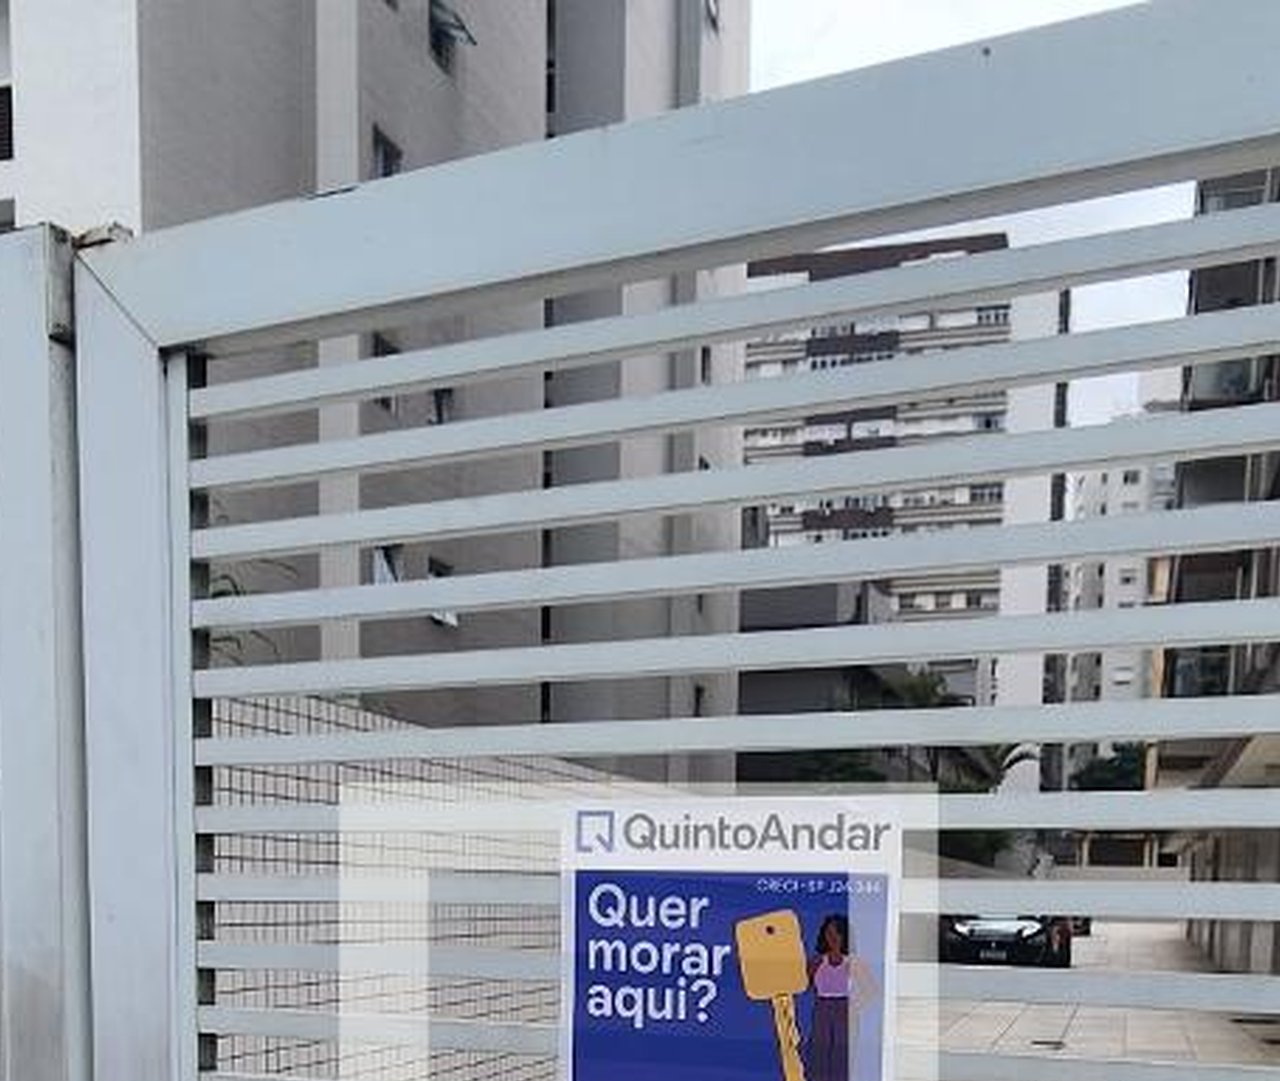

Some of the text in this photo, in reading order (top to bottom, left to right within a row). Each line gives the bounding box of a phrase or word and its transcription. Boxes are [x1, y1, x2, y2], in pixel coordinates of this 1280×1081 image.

[623, 813, 892, 852] QuintoAndar
[588, 883, 709, 929] Quer
[588, 939, 731, 975] morar
[587, 977, 718, 1028] aqui?
